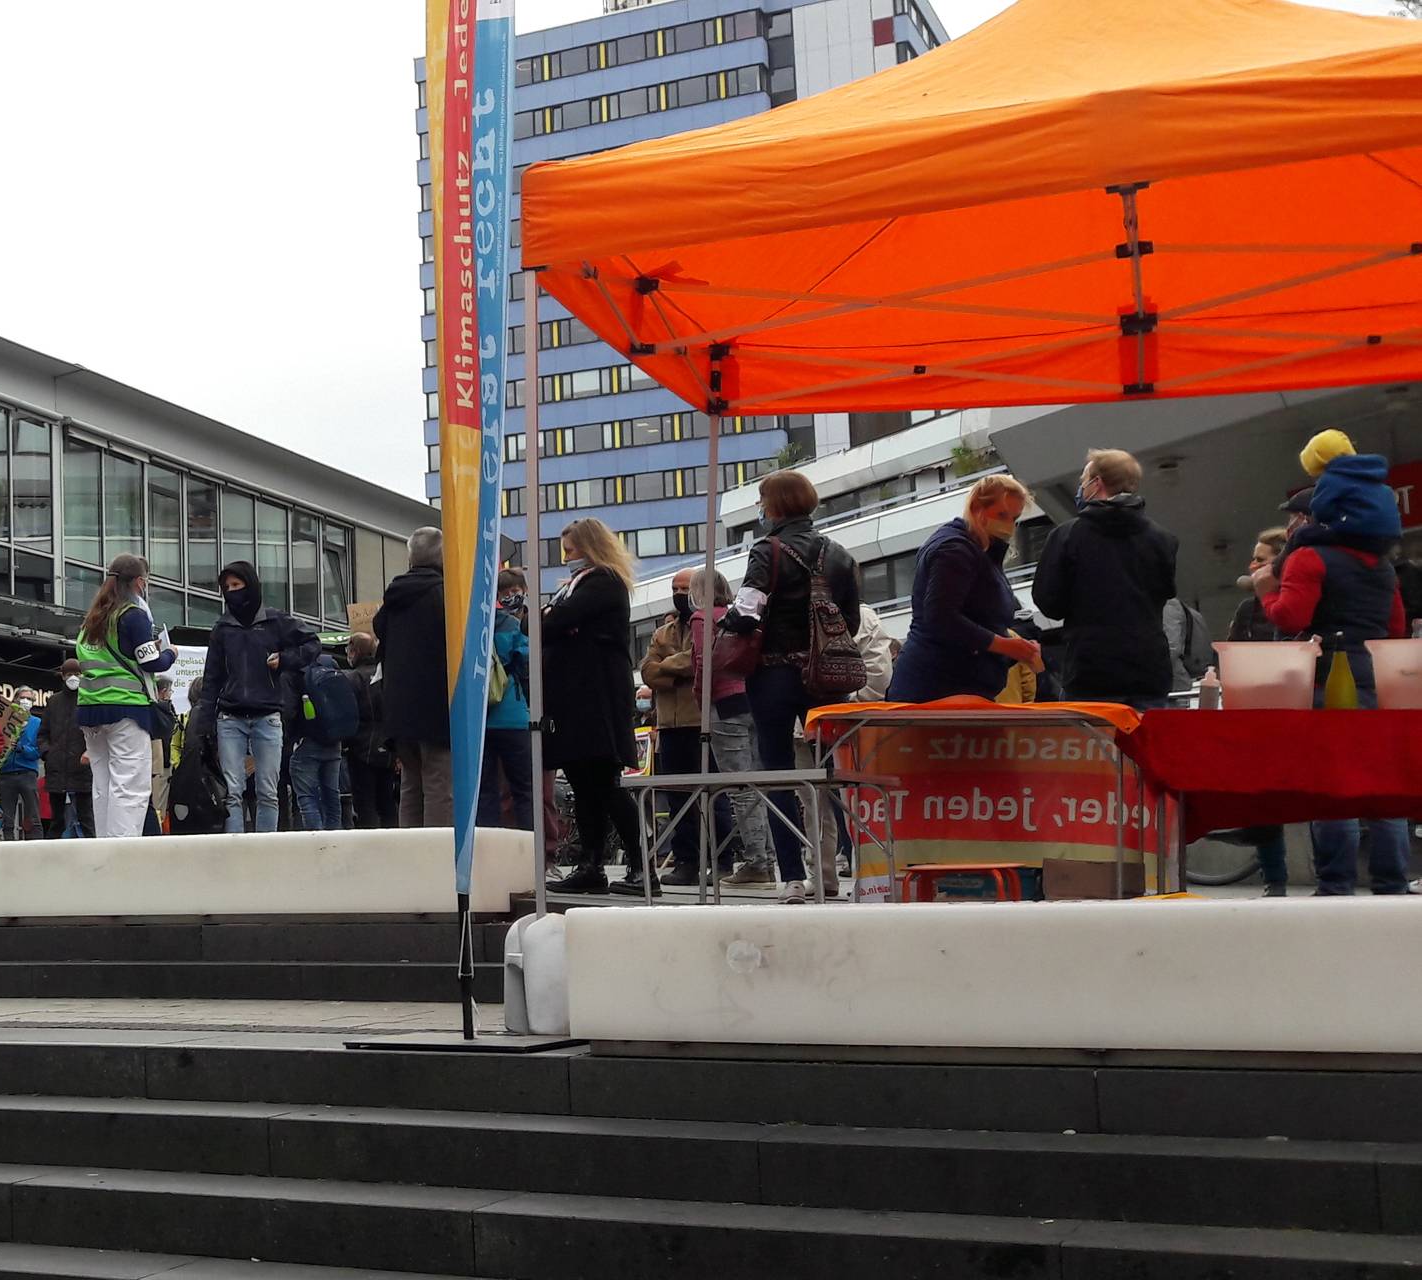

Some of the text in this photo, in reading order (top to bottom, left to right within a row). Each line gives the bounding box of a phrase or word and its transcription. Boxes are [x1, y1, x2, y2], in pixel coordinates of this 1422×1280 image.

[454, 150, 474, 409] Klimaschutz
[472, 87, 496, 300] recht
[479, 334, 500, 488] erst
[174, 678, 186, 688] die
